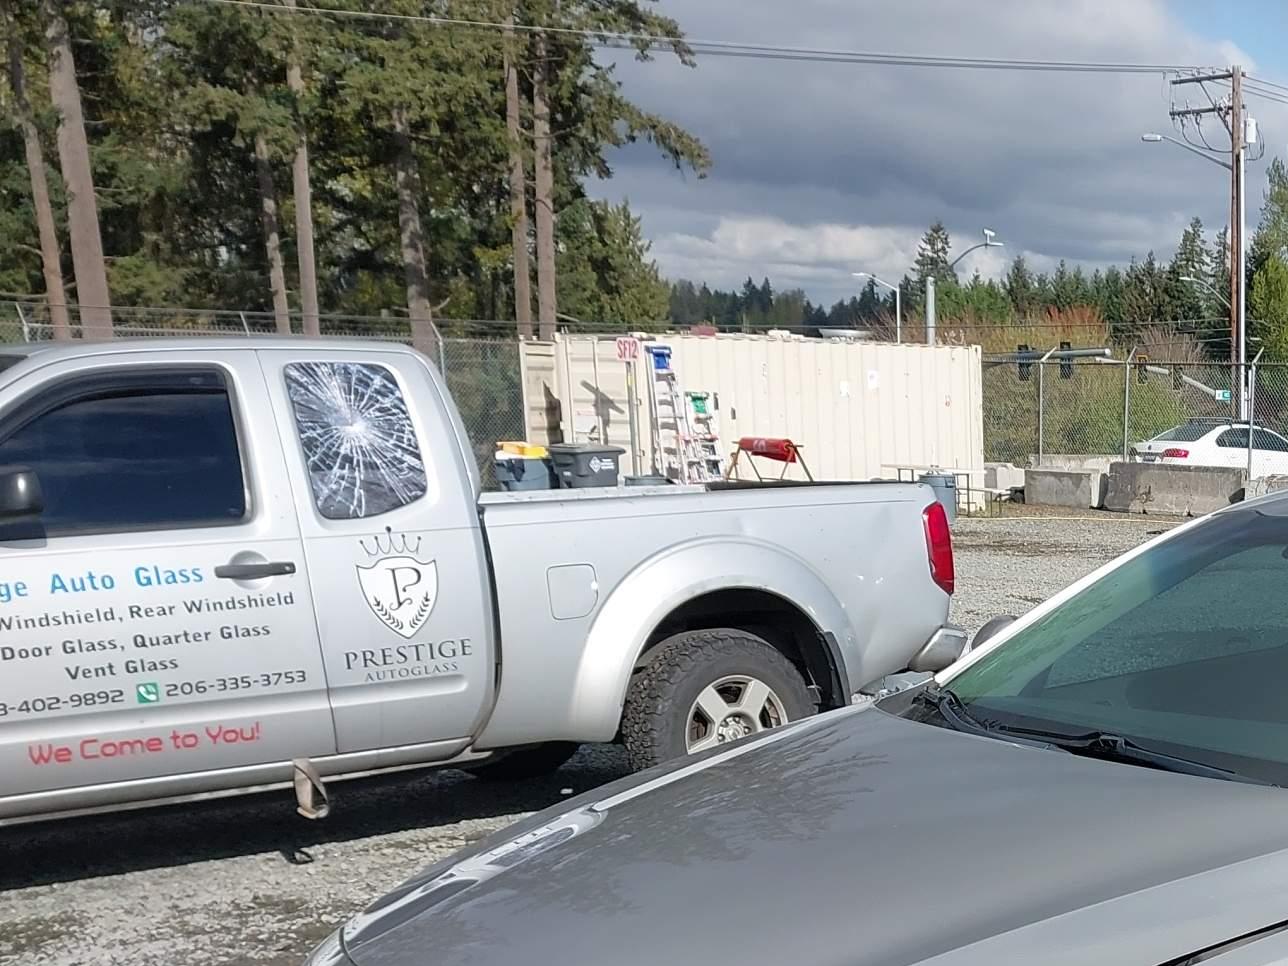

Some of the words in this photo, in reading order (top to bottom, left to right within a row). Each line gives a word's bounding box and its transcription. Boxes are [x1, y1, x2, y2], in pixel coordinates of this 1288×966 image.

[617, 340, 638, 359] SF12
[50, 571, 115, 594] Auto
[134, 565, 204, 588] Glass
[128, 604, 176, 619] Rear
[183, 592, 295, 615] Windshield
[1, 645, 53, 661] Door
[61, 638, 125, 655] Glass,
[132, 630, 212, 649] Quarter
[219, 625, 271, 640] Glass
[344, 638, 473, 671] PRESTIGE
[64, 662, 117, 681] Vent
[125, 658, 179, 674] Glass
[364, 661, 459, 683] AUTOGLASS
[165, 670, 307, 697] 206-335-3753
[28, 743, 73, 766] We
[80, 737, 163, 760] Come
[169, 730, 199, 749] to
[205, 721, 261, 745] You!
